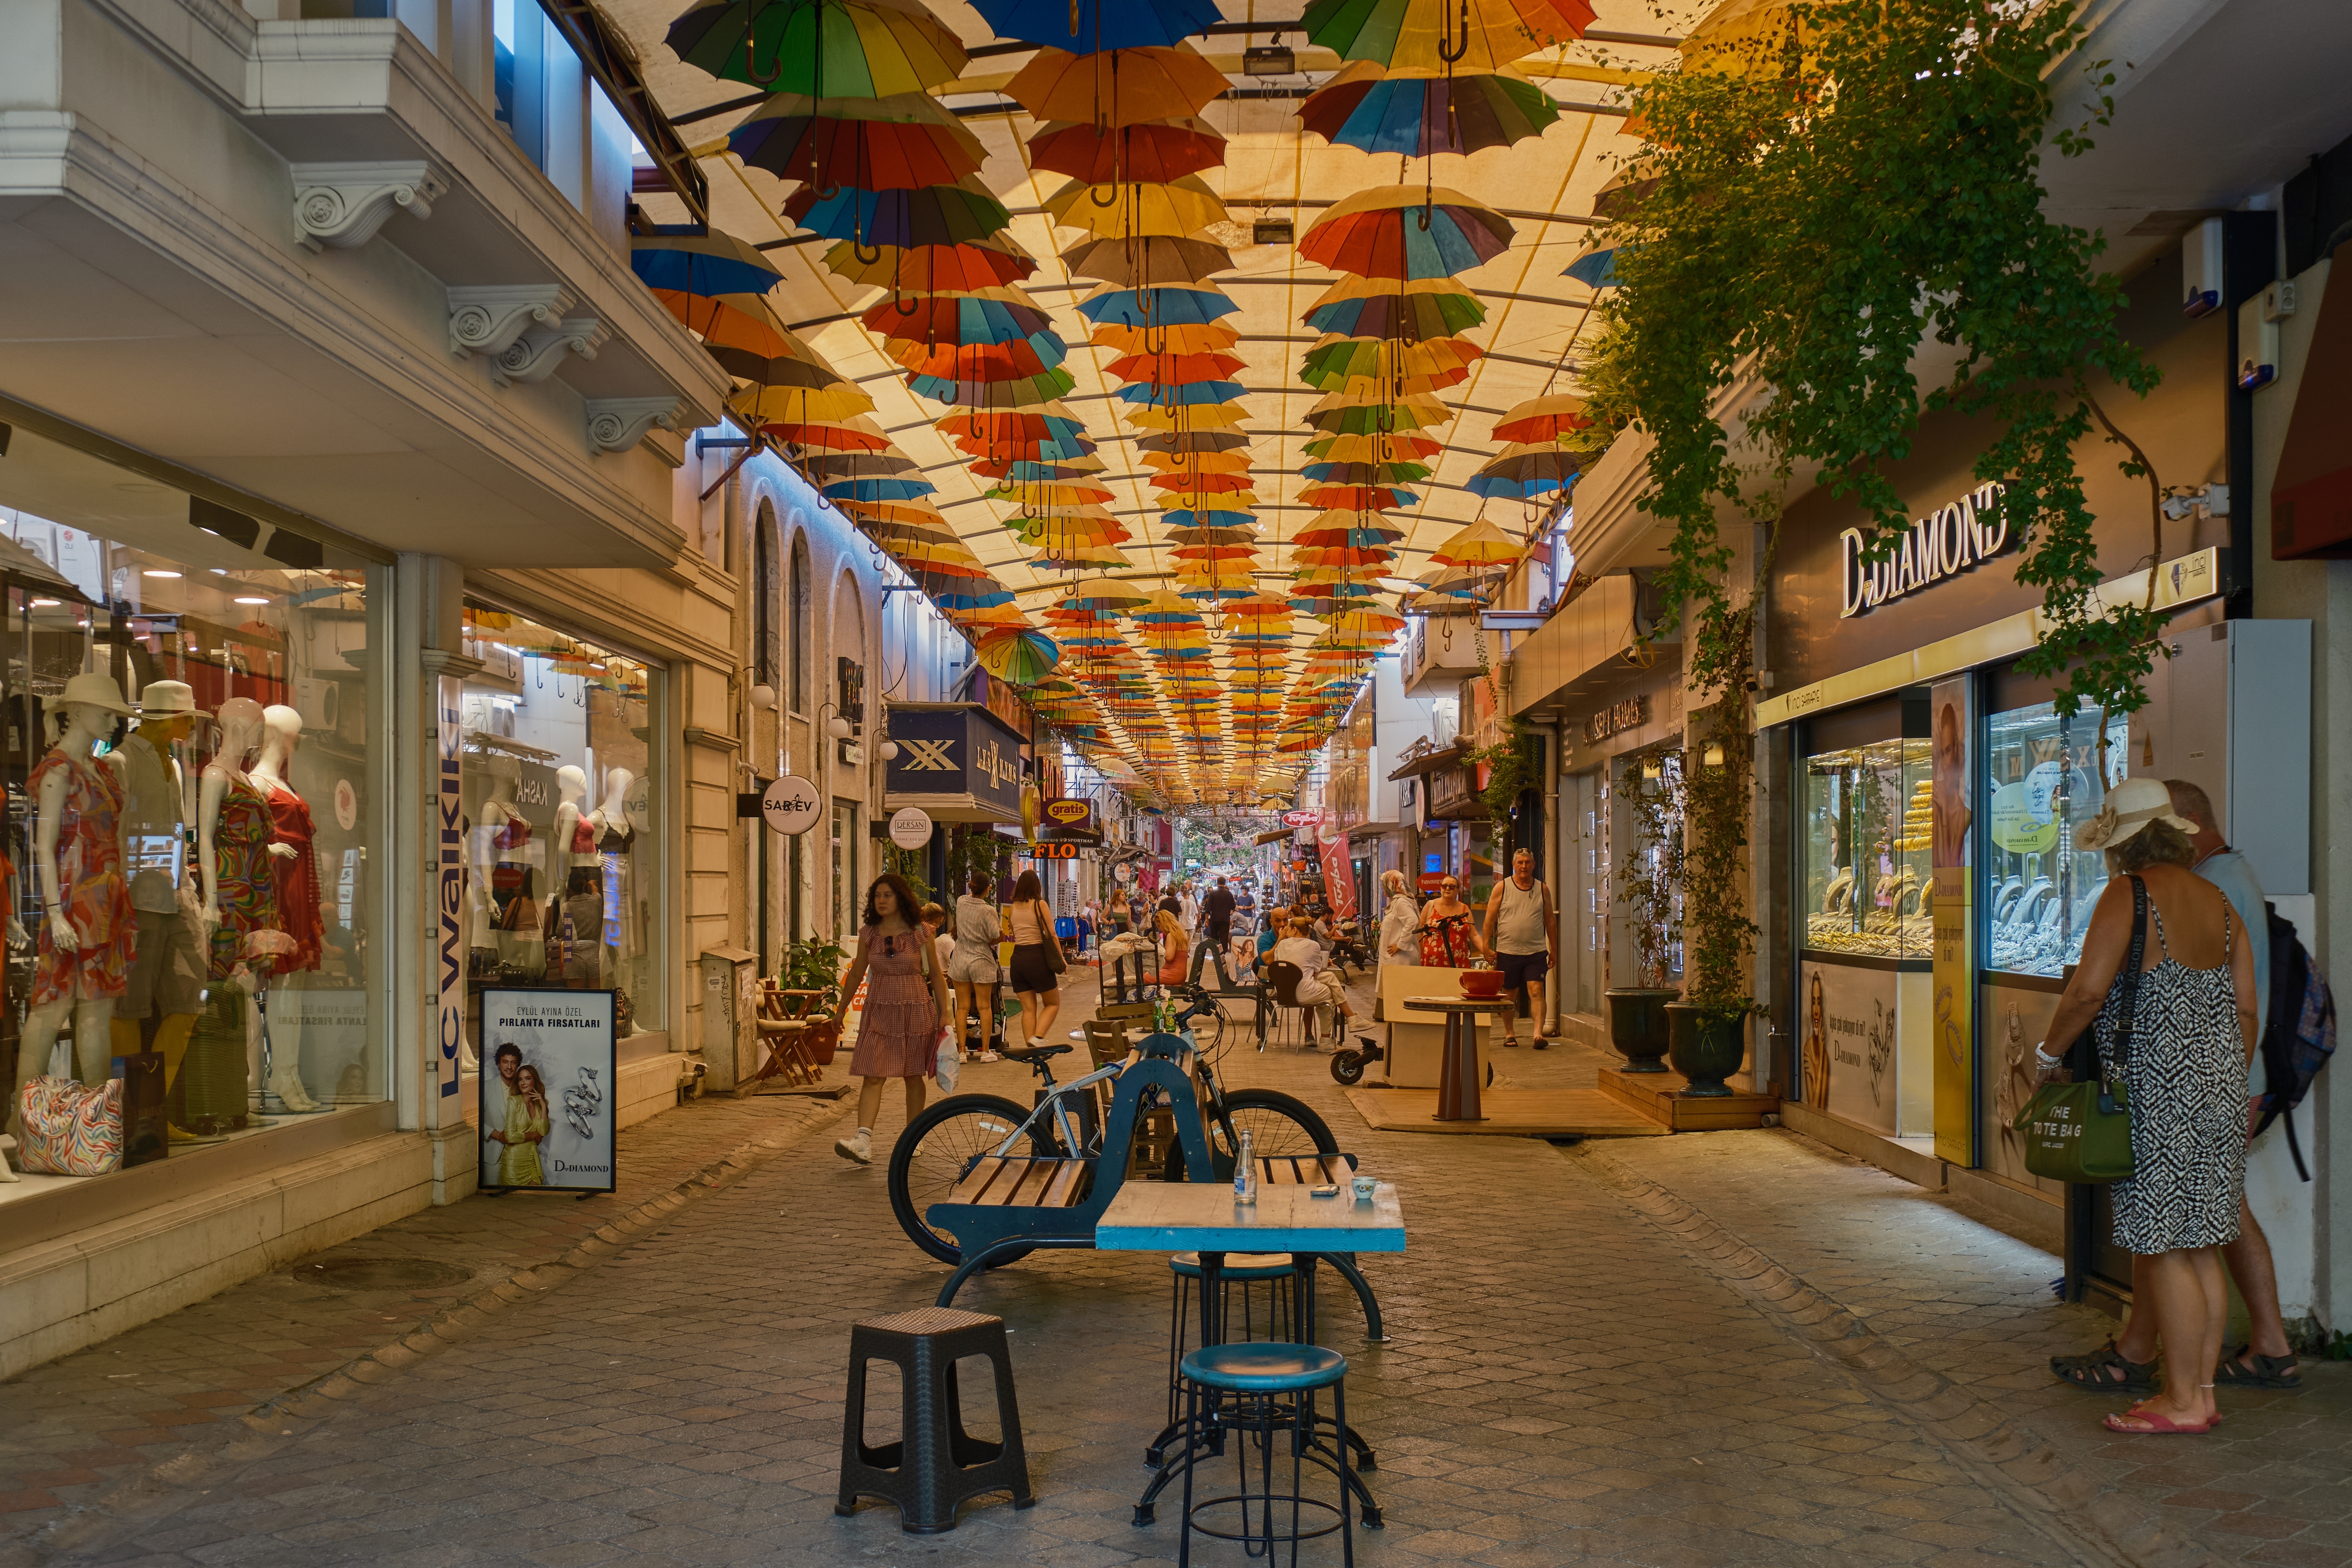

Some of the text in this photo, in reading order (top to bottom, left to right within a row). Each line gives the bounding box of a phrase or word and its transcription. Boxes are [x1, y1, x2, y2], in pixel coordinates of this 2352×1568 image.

[1052, 803, 1084, 816] gratis
[1034, 843, 1076, 858] FLO
[2128, 935, 2144, 984] JACOBS
[517, 1005, 583, 1016] EYLÜL AYINA ÖZEL
[499, 1018, 600, 1028] PIRLANTA FIRSATLARI
[2049, 1106, 2071, 1119] THE
[2059, 1124, 2082, 1137] BAG
